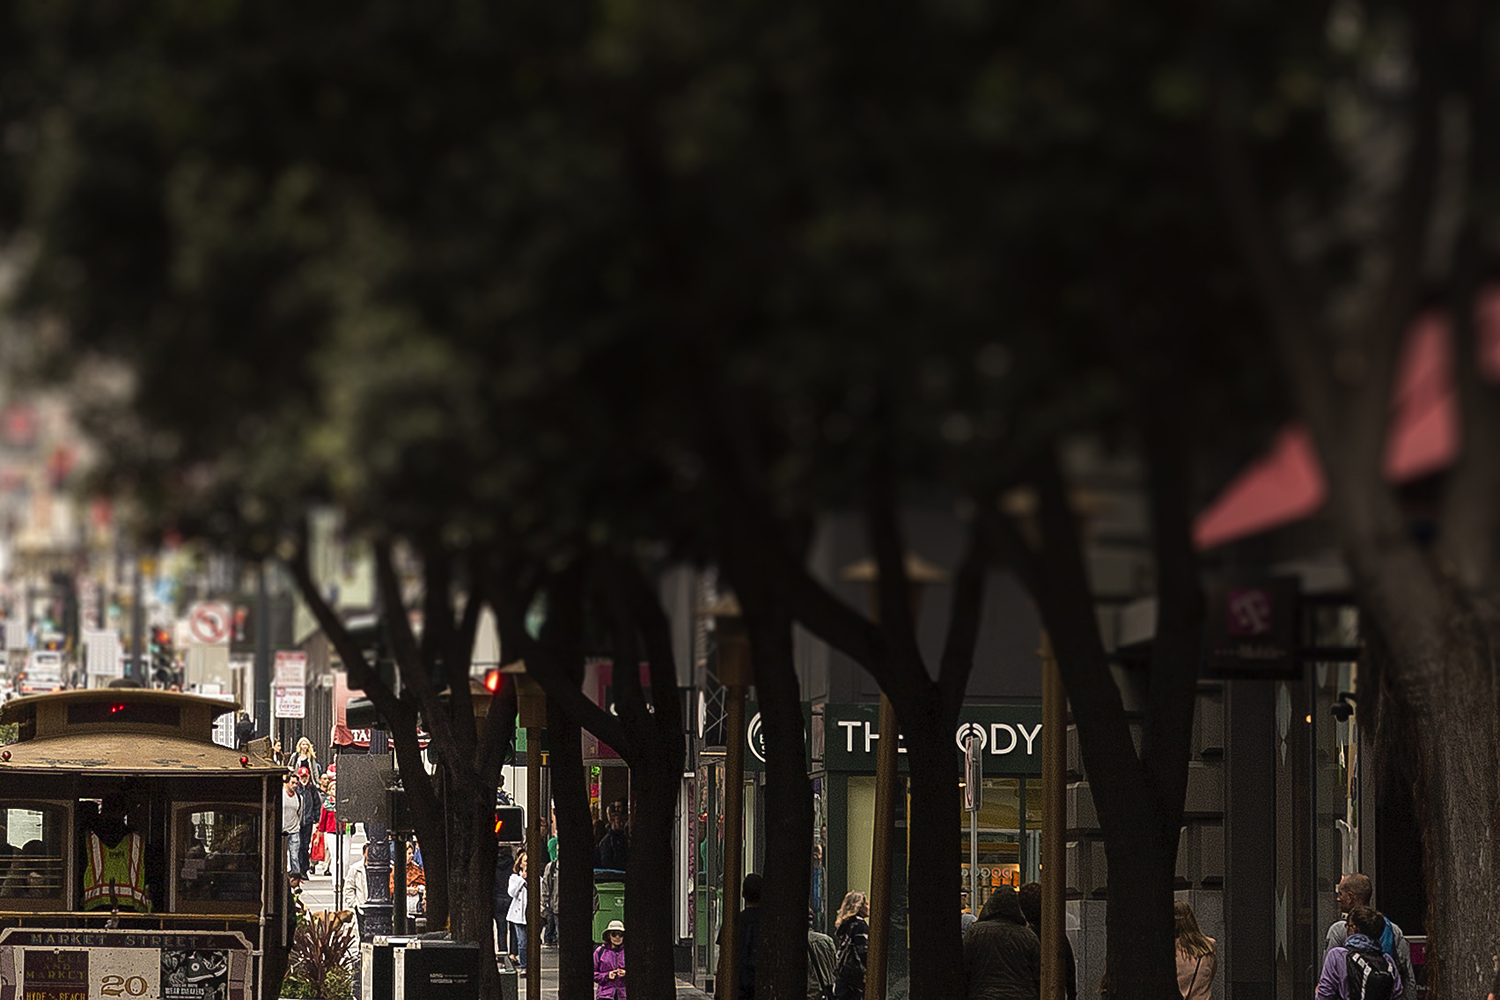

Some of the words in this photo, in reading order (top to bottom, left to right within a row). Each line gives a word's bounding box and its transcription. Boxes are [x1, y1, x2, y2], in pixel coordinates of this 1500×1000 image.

[837, 720, 908, 753] TH
[955, 722, 1043, 755] ODY
[31, 934, 108, 946] MARKET
[125, 935, 200, 948] STREET
[26, 971, 85, 980] MARKET
[100, 975, 148, 997] 20
